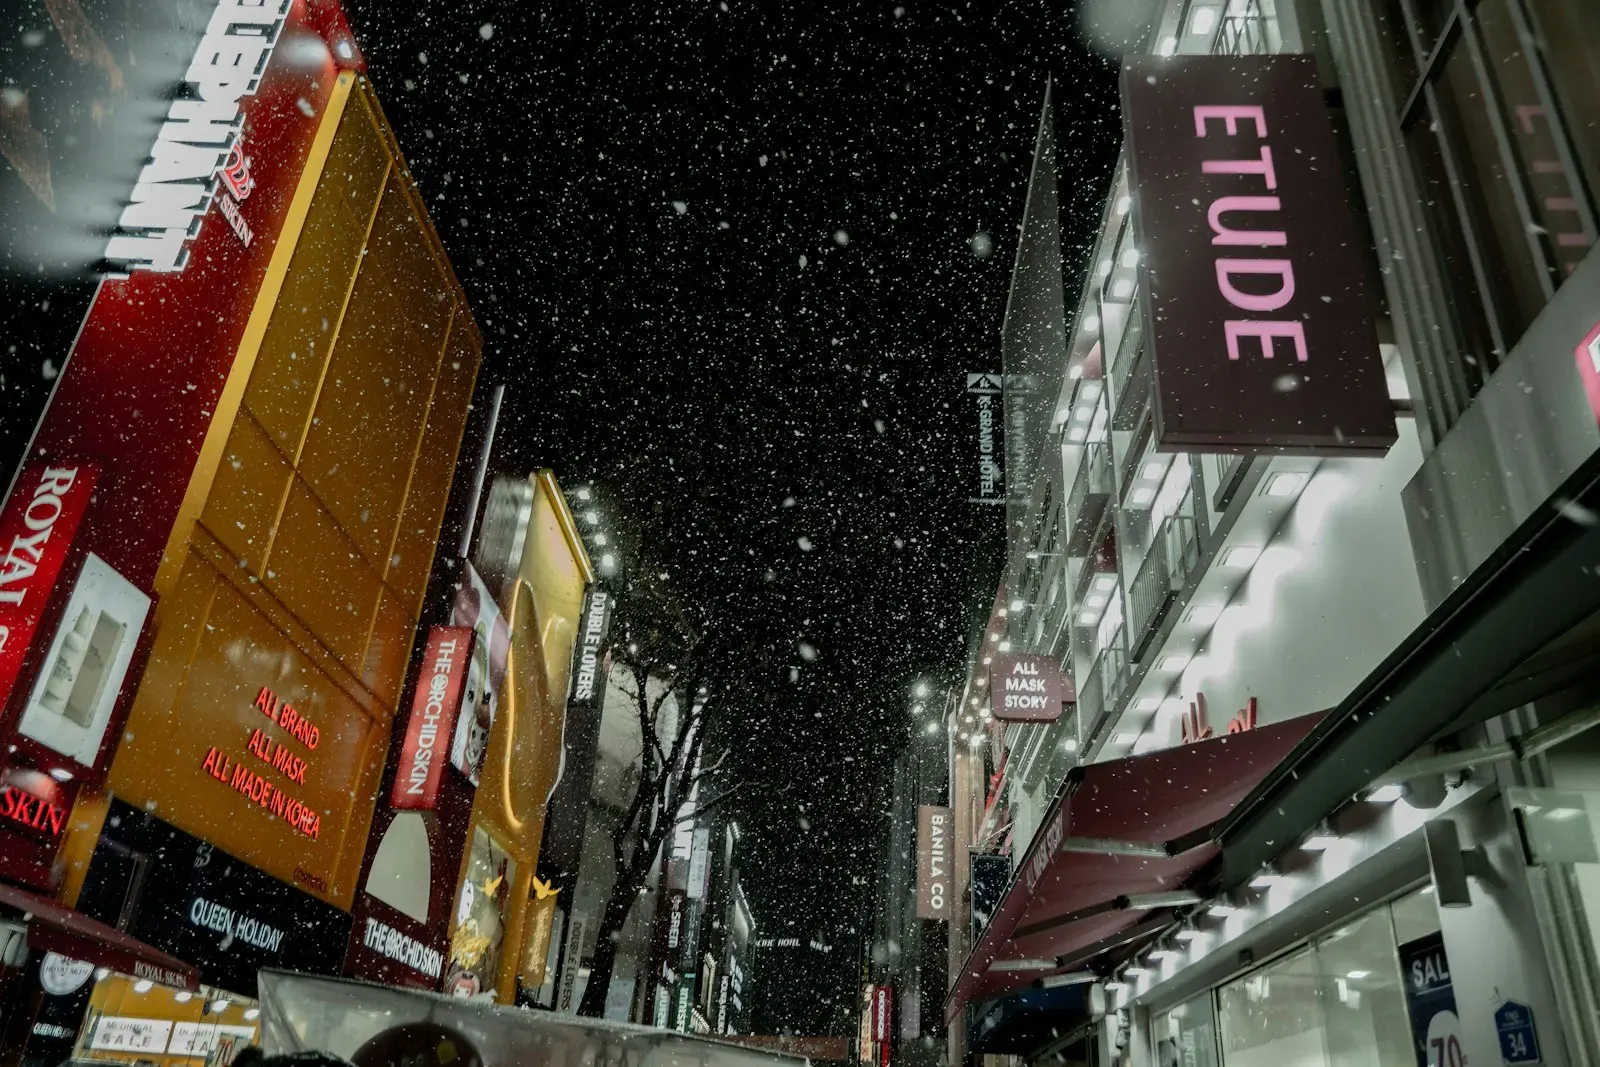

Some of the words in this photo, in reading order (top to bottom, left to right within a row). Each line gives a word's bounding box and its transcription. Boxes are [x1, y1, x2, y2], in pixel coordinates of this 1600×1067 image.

[104, 0, 292, 276] LEPHANT
[1193, 105, 1308, 362] ETUDE
[980, 454, 994, 497] HOTEL
[585, 592, 607, 644] DOUBLE
[575, 646, 598, 700] LOVERS
[1005, 678, 1046, 692] MASK
[1013, 662, 1039, 675] ALL
[256, 686, 280, 722] ALL
[279, 703, 320, 750] BRAND
[1004, 695, 1048, 709] STORY
[248, 728, 271, 763] ALL
[271, 744, 308, 786] MASK
[0, 785, 66, 836] SKIN
[202, 747, 230, 783] ALL
[230, 763, 272, 808] MADE
[269, 788, 287, 817] IN
[284, 799, 320, 840] KOREA
[931, 815, 944, 878] BANILA
[931, 883, 944, 909] CO
[190, 897, 235, 935] QUEEN
[235, 917, 285, 952] HOLIDAY
[134, 960, 164, 982] ROYAL
[165, 970, 187, 988] SKIN
[1412, 953, 1449, 987] SAL
[1508, 1032, 1527, 1058] 34
